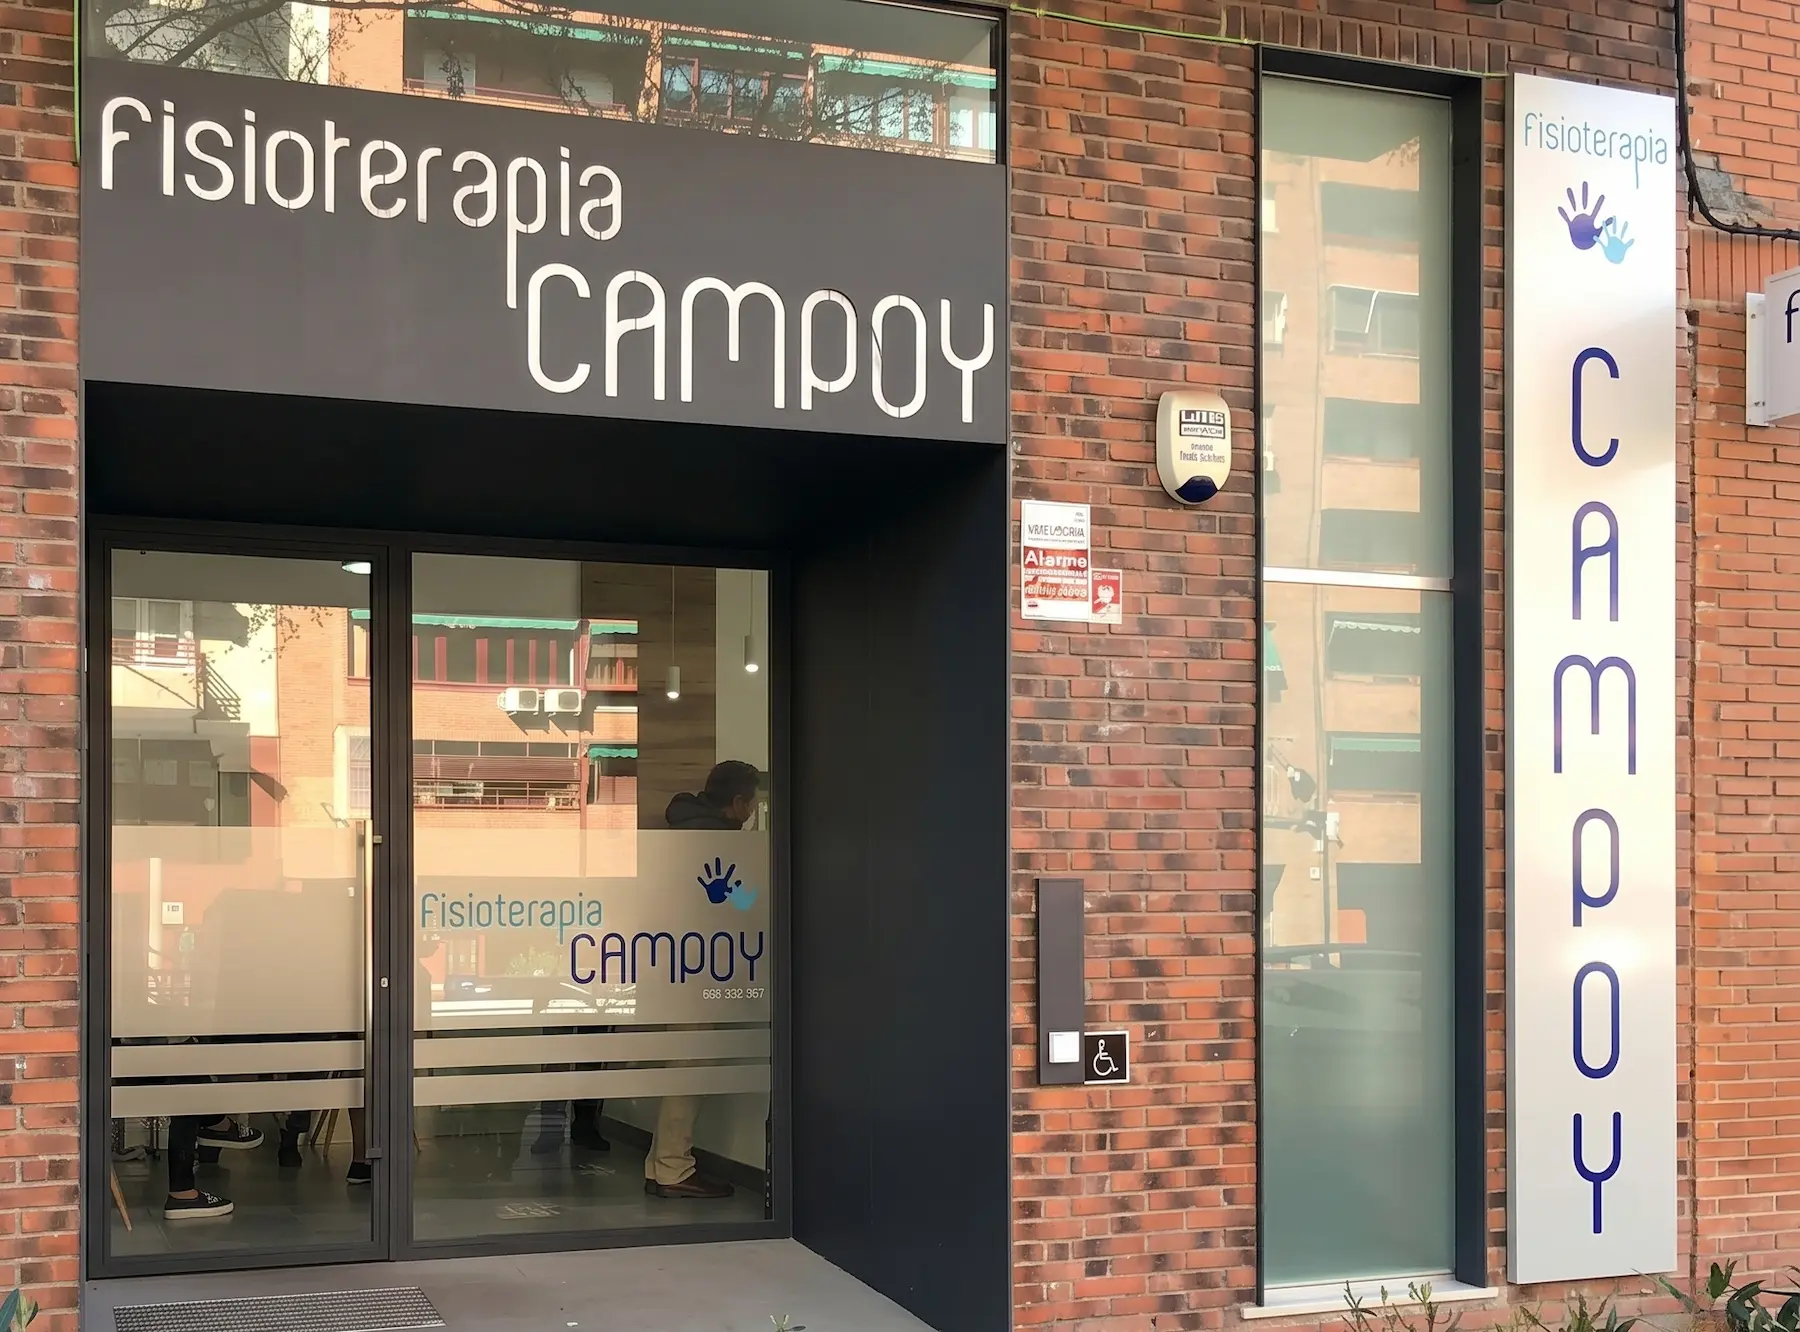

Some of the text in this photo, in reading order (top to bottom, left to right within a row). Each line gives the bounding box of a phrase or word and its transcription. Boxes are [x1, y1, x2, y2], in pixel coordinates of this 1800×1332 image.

[1524, 112, 1668, 189] fisioterapia
[101, 95, 623, 310] fisioterapia
[526, 262, 995, 424] CAMPOY
[1553, 346, 1637, 1235] CAMPOY
[420, 892, 603, 945] fisioterapia
[570, 931, 764, 984] CAMPOY
[724, 988, 744, 999] 332
